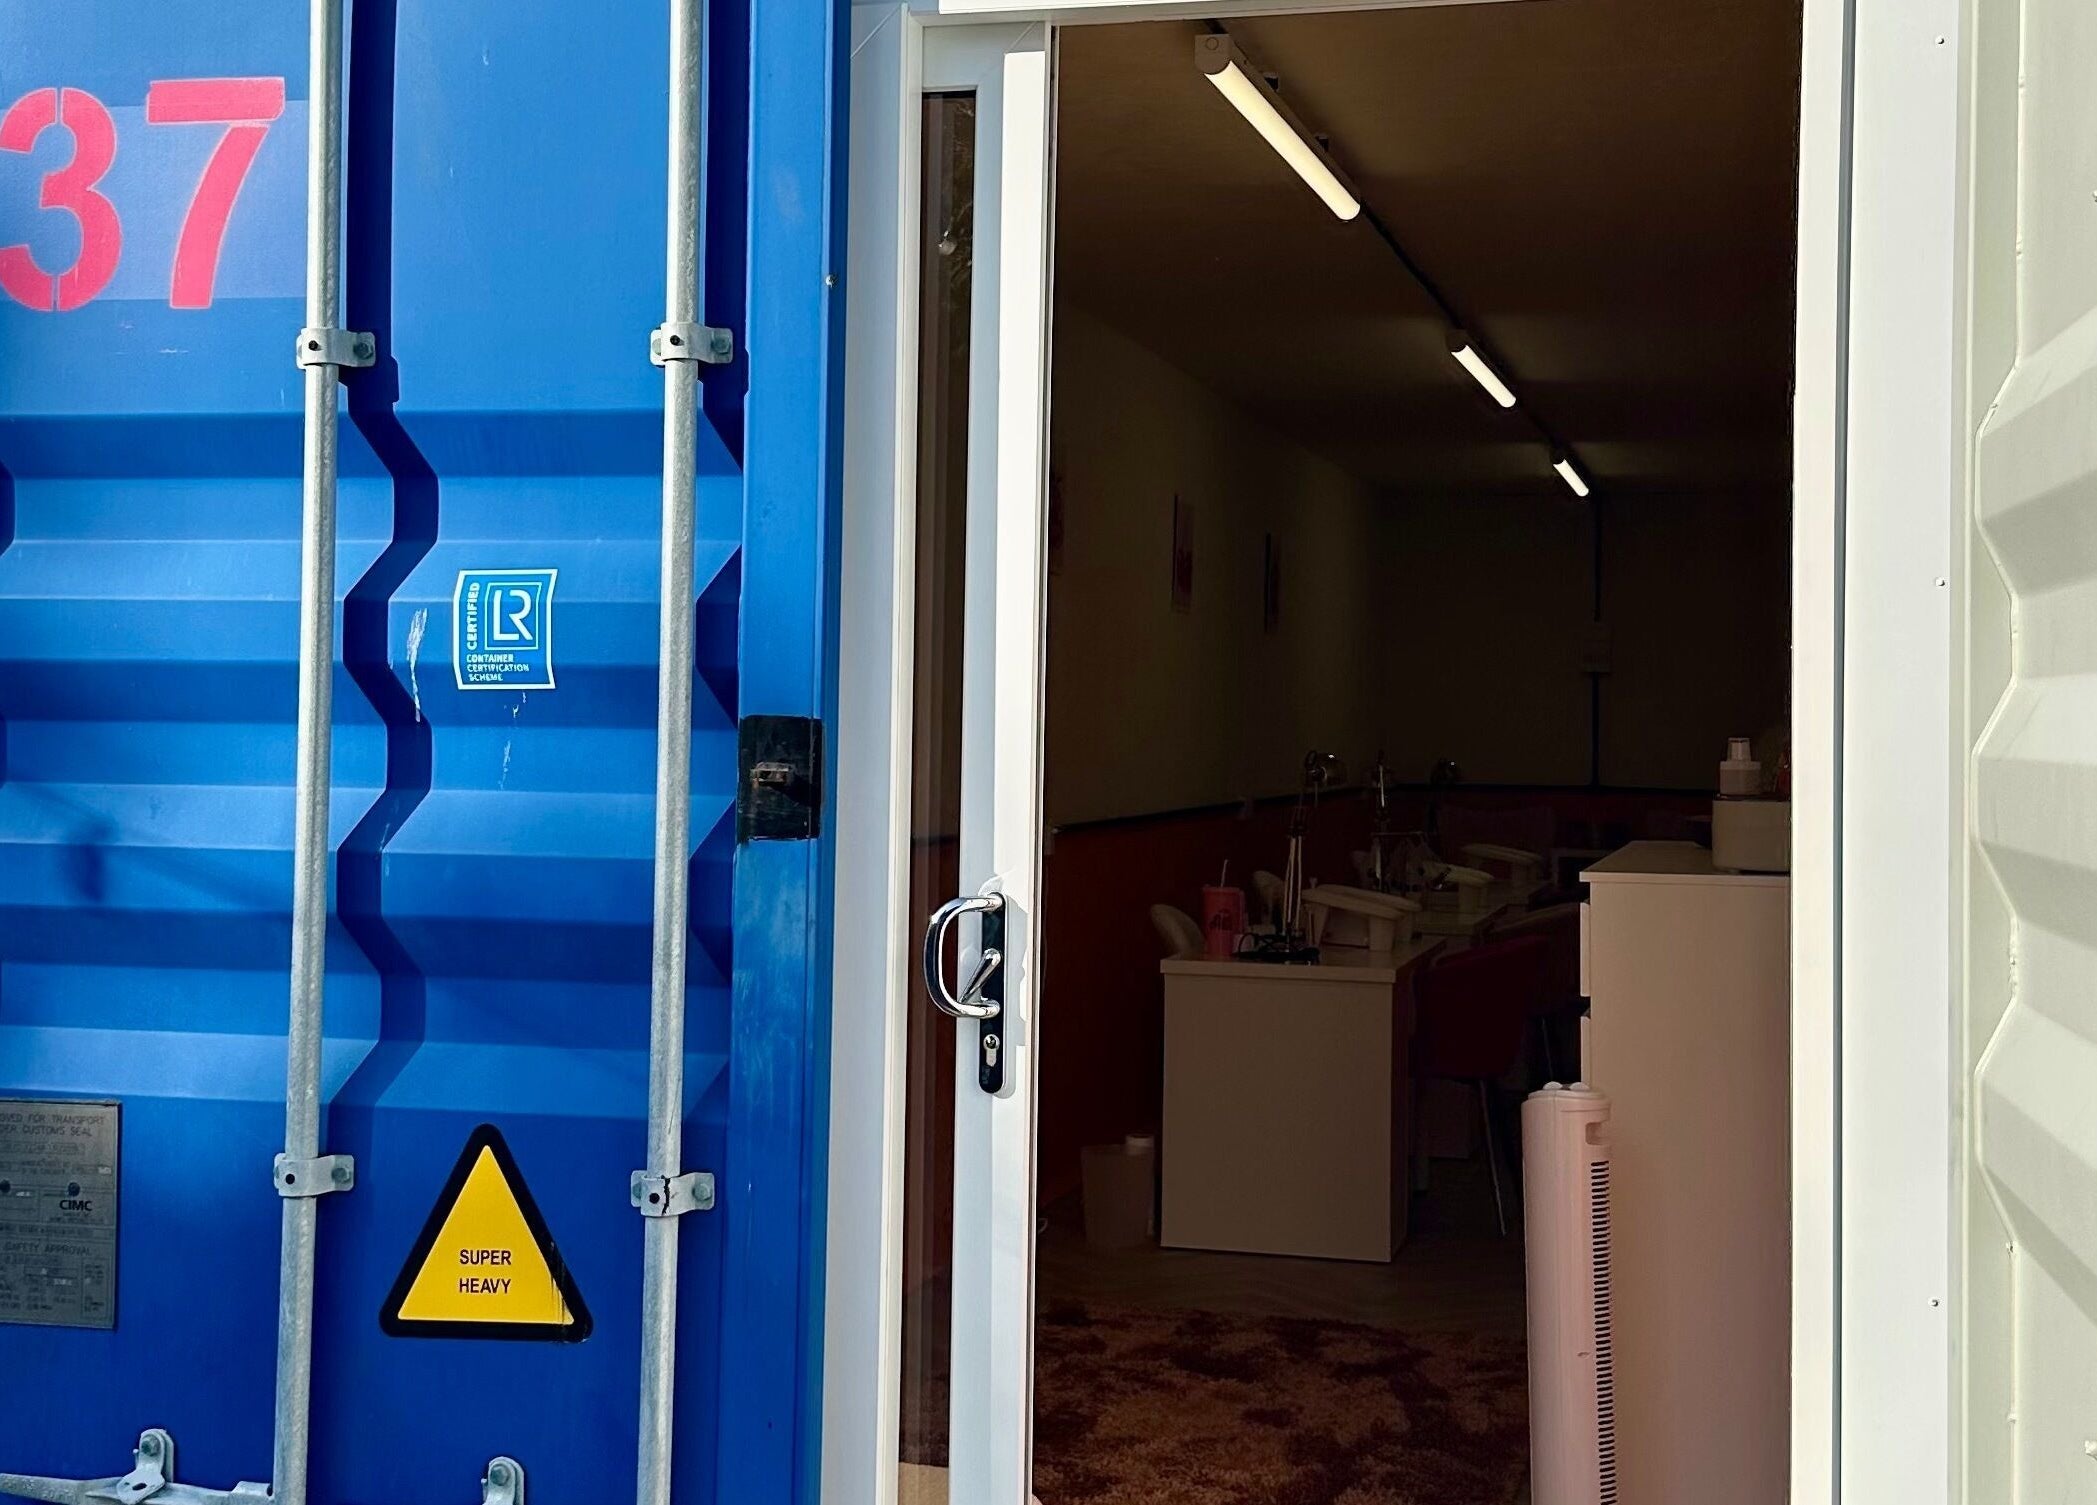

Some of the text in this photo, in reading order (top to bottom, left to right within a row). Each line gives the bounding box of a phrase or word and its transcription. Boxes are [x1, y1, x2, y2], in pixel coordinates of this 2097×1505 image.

[0, 77, 286, 311] 37
[467, 582, 480, 650] CERTIFIED
[493, 589, 533, 641] LR
[466, 653, 514, 663] CONTAINER
[466, 664, 530, 672] CERTIFICATION
[468, 673, 503, 682] SCHEME
[59, 1200, 93, 1212] CIMC
[459, 1249, 512, 1265] SUPER
[459, 1277, 512, 1294] HEAVY
